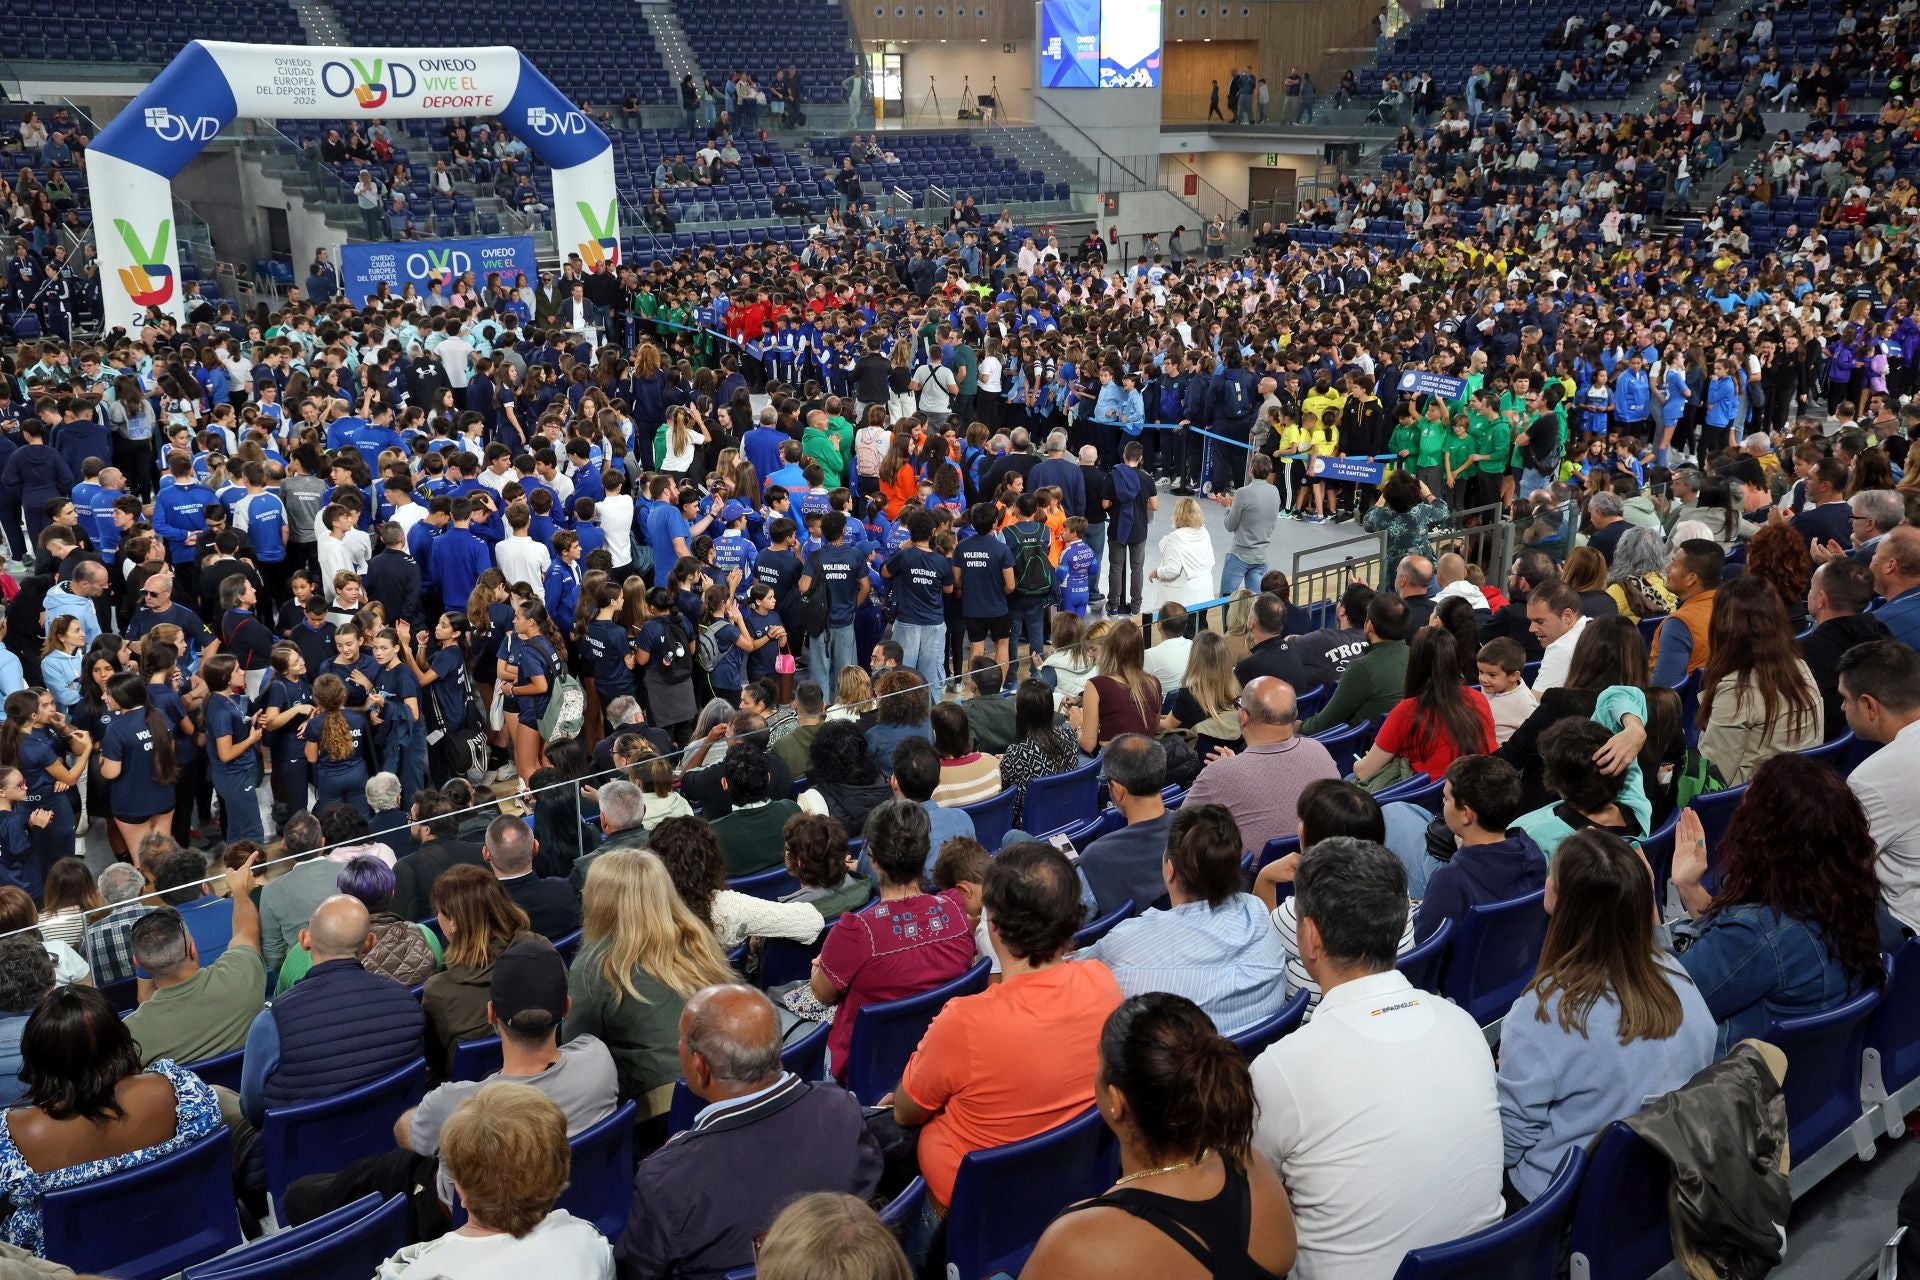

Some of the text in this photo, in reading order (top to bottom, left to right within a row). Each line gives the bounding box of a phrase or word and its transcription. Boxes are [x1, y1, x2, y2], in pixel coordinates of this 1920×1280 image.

[275, 58, 312, 67] OVIEDO
[419, 58, 477, 71] OVIEDO
[278, 67, 314, 76] CIUDAD
[273, 76, 316, 86] EUROPEA
[422, 76, 477, 91] VIVE EL
[256, 86, 316, 96] DEL DEPORTE
[293, 96, 316, 105] 2026
[422, 95, 494, 109] DEPORTE
[481, 248, 516, 258] OVIEDO
[482, 259, 515, 269] VIVE EL
[368, 267, 397, 275] EUROPEA
[357, 275, 370, 283] DEL
[1347, 464, 1377, 473] ATLETISMO
[757, 565, 780, 577] VOLEIBOL
[823, 563, 851, 571] VOLEIBOL
[910, 568, 938, 578] VOLEIBOL
[760, 575, 778, 584] OVIEDO
[912, 576, 933, 585] OVIEDO
